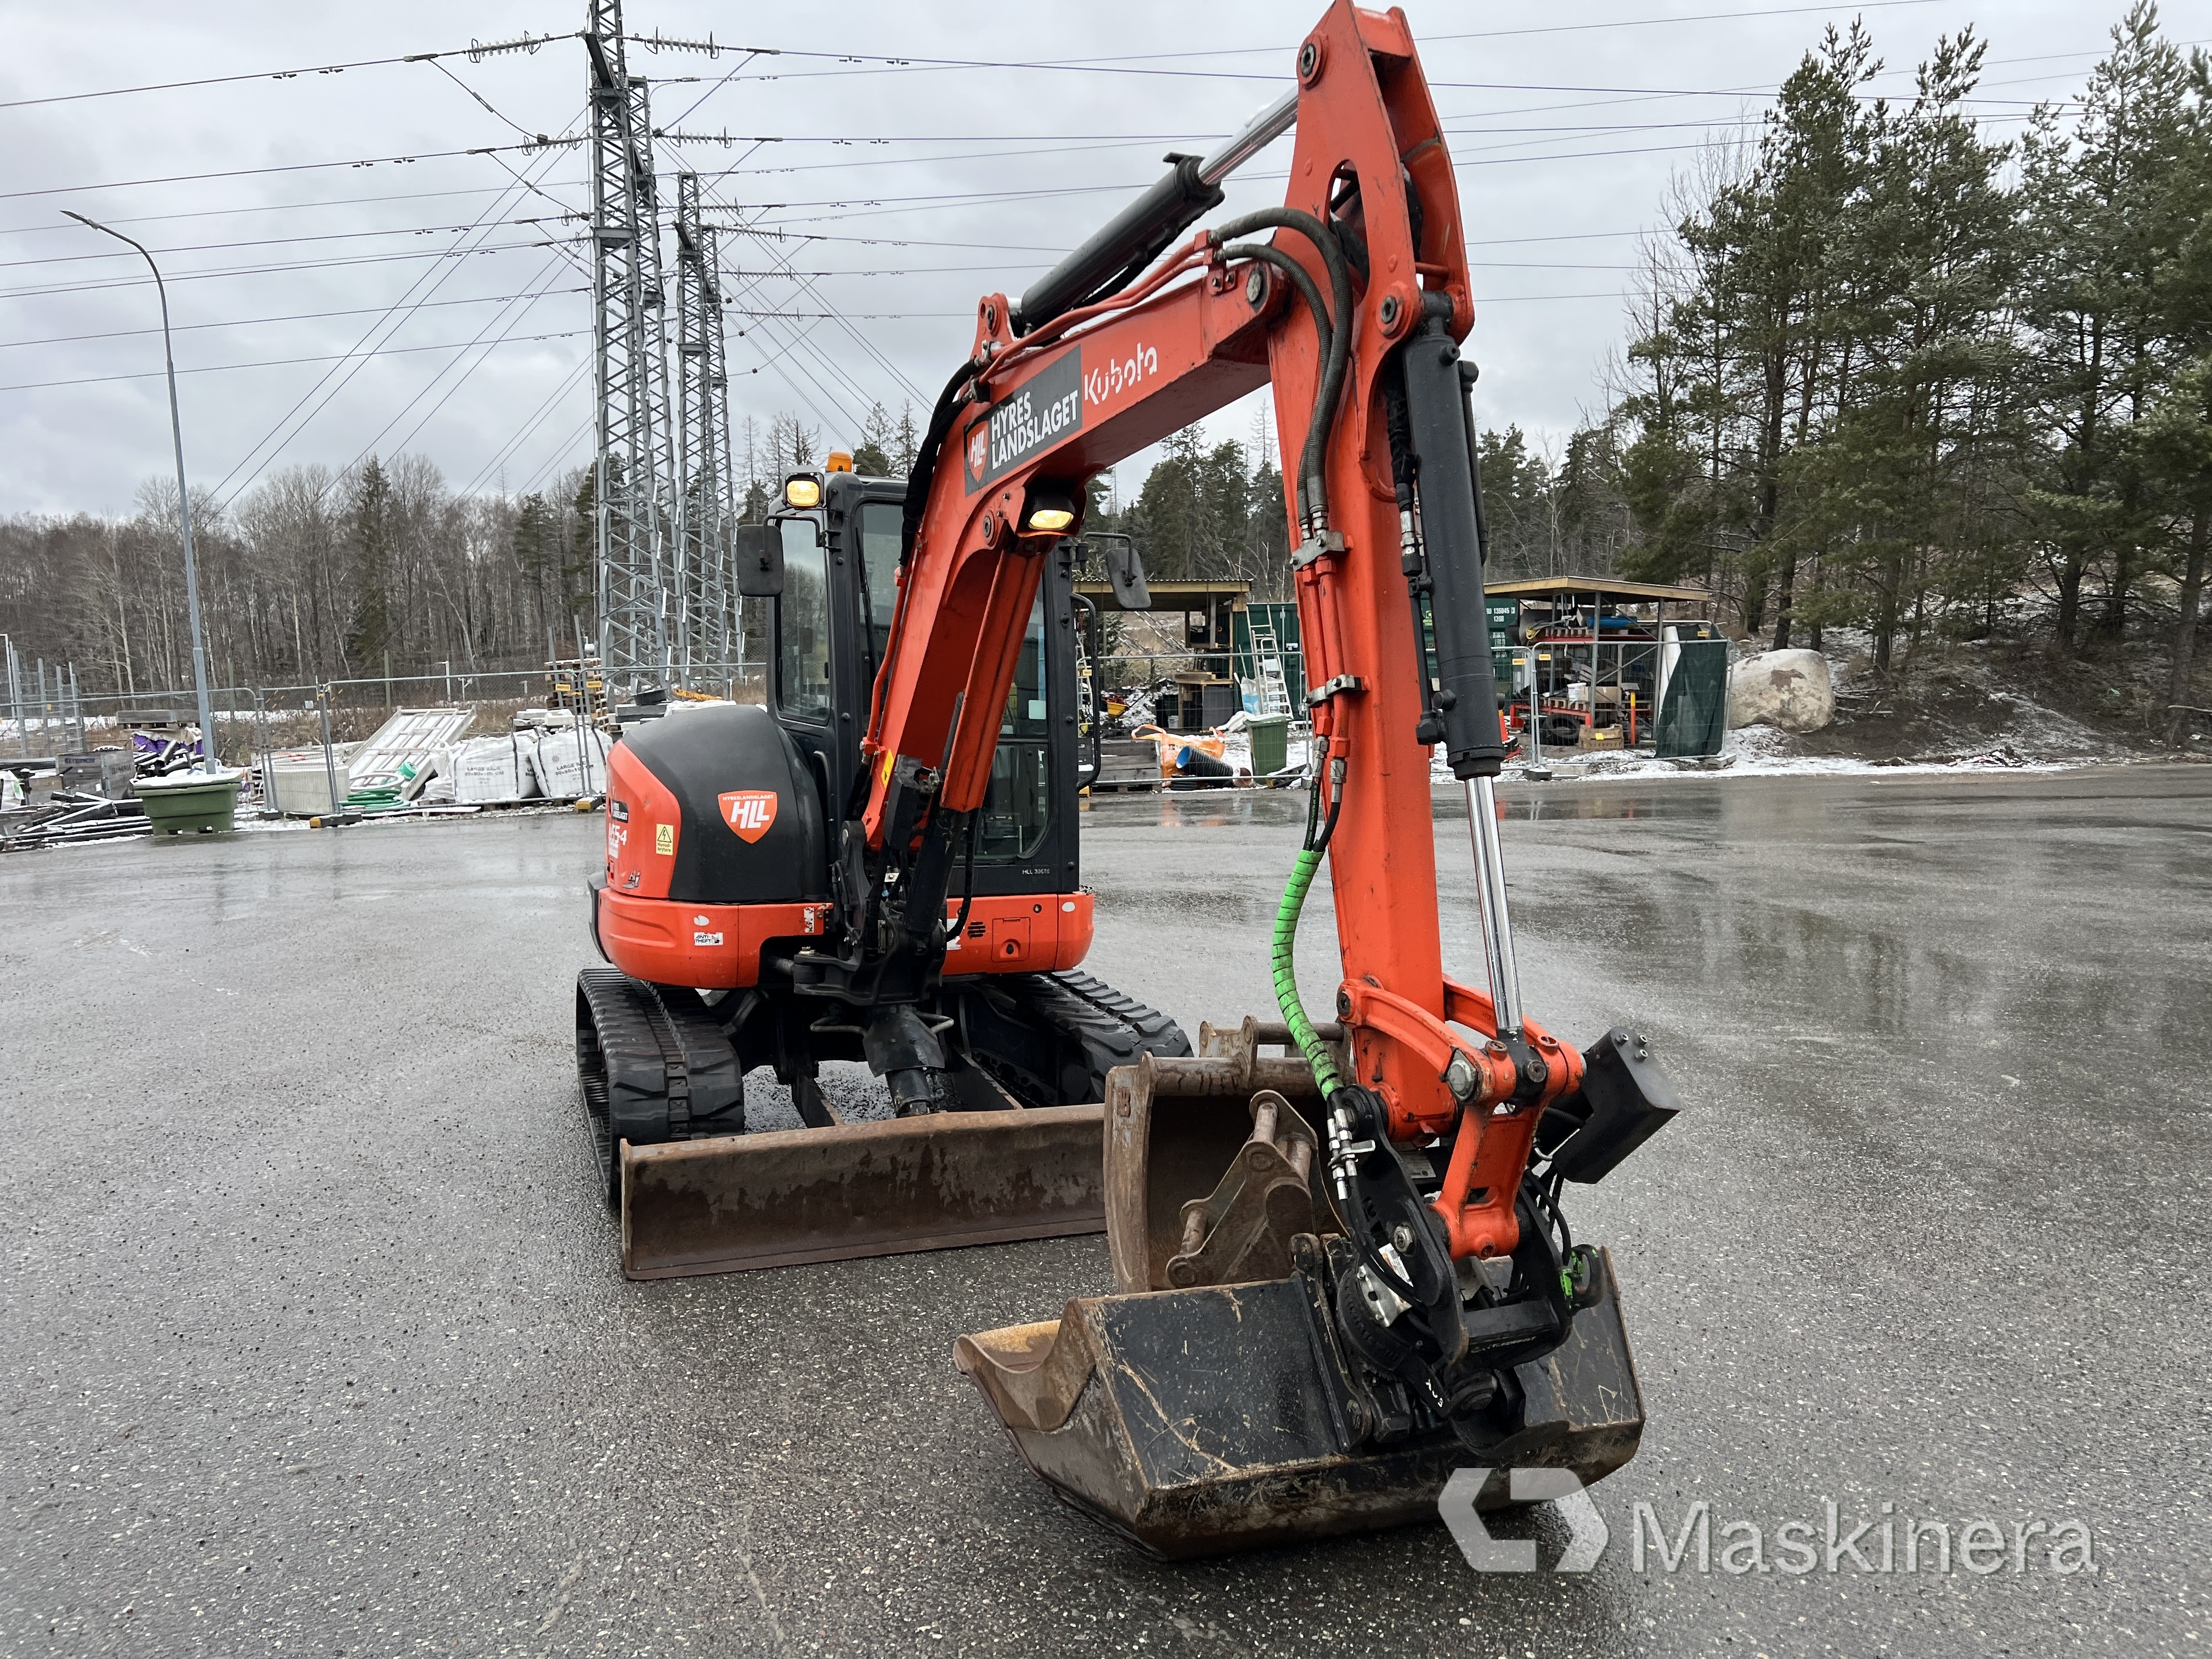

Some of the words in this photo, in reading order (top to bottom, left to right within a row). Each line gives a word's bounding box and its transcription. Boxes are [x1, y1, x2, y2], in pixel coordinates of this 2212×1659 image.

[1085, 342, 1158, 405] Kubota
[991, 391, 1031, 442] HYRES
[992, 390, 1079, 470] LANDSLAGET
[970, 430, 986, 467] HLL
[730, 800, 770, 830] HLL
